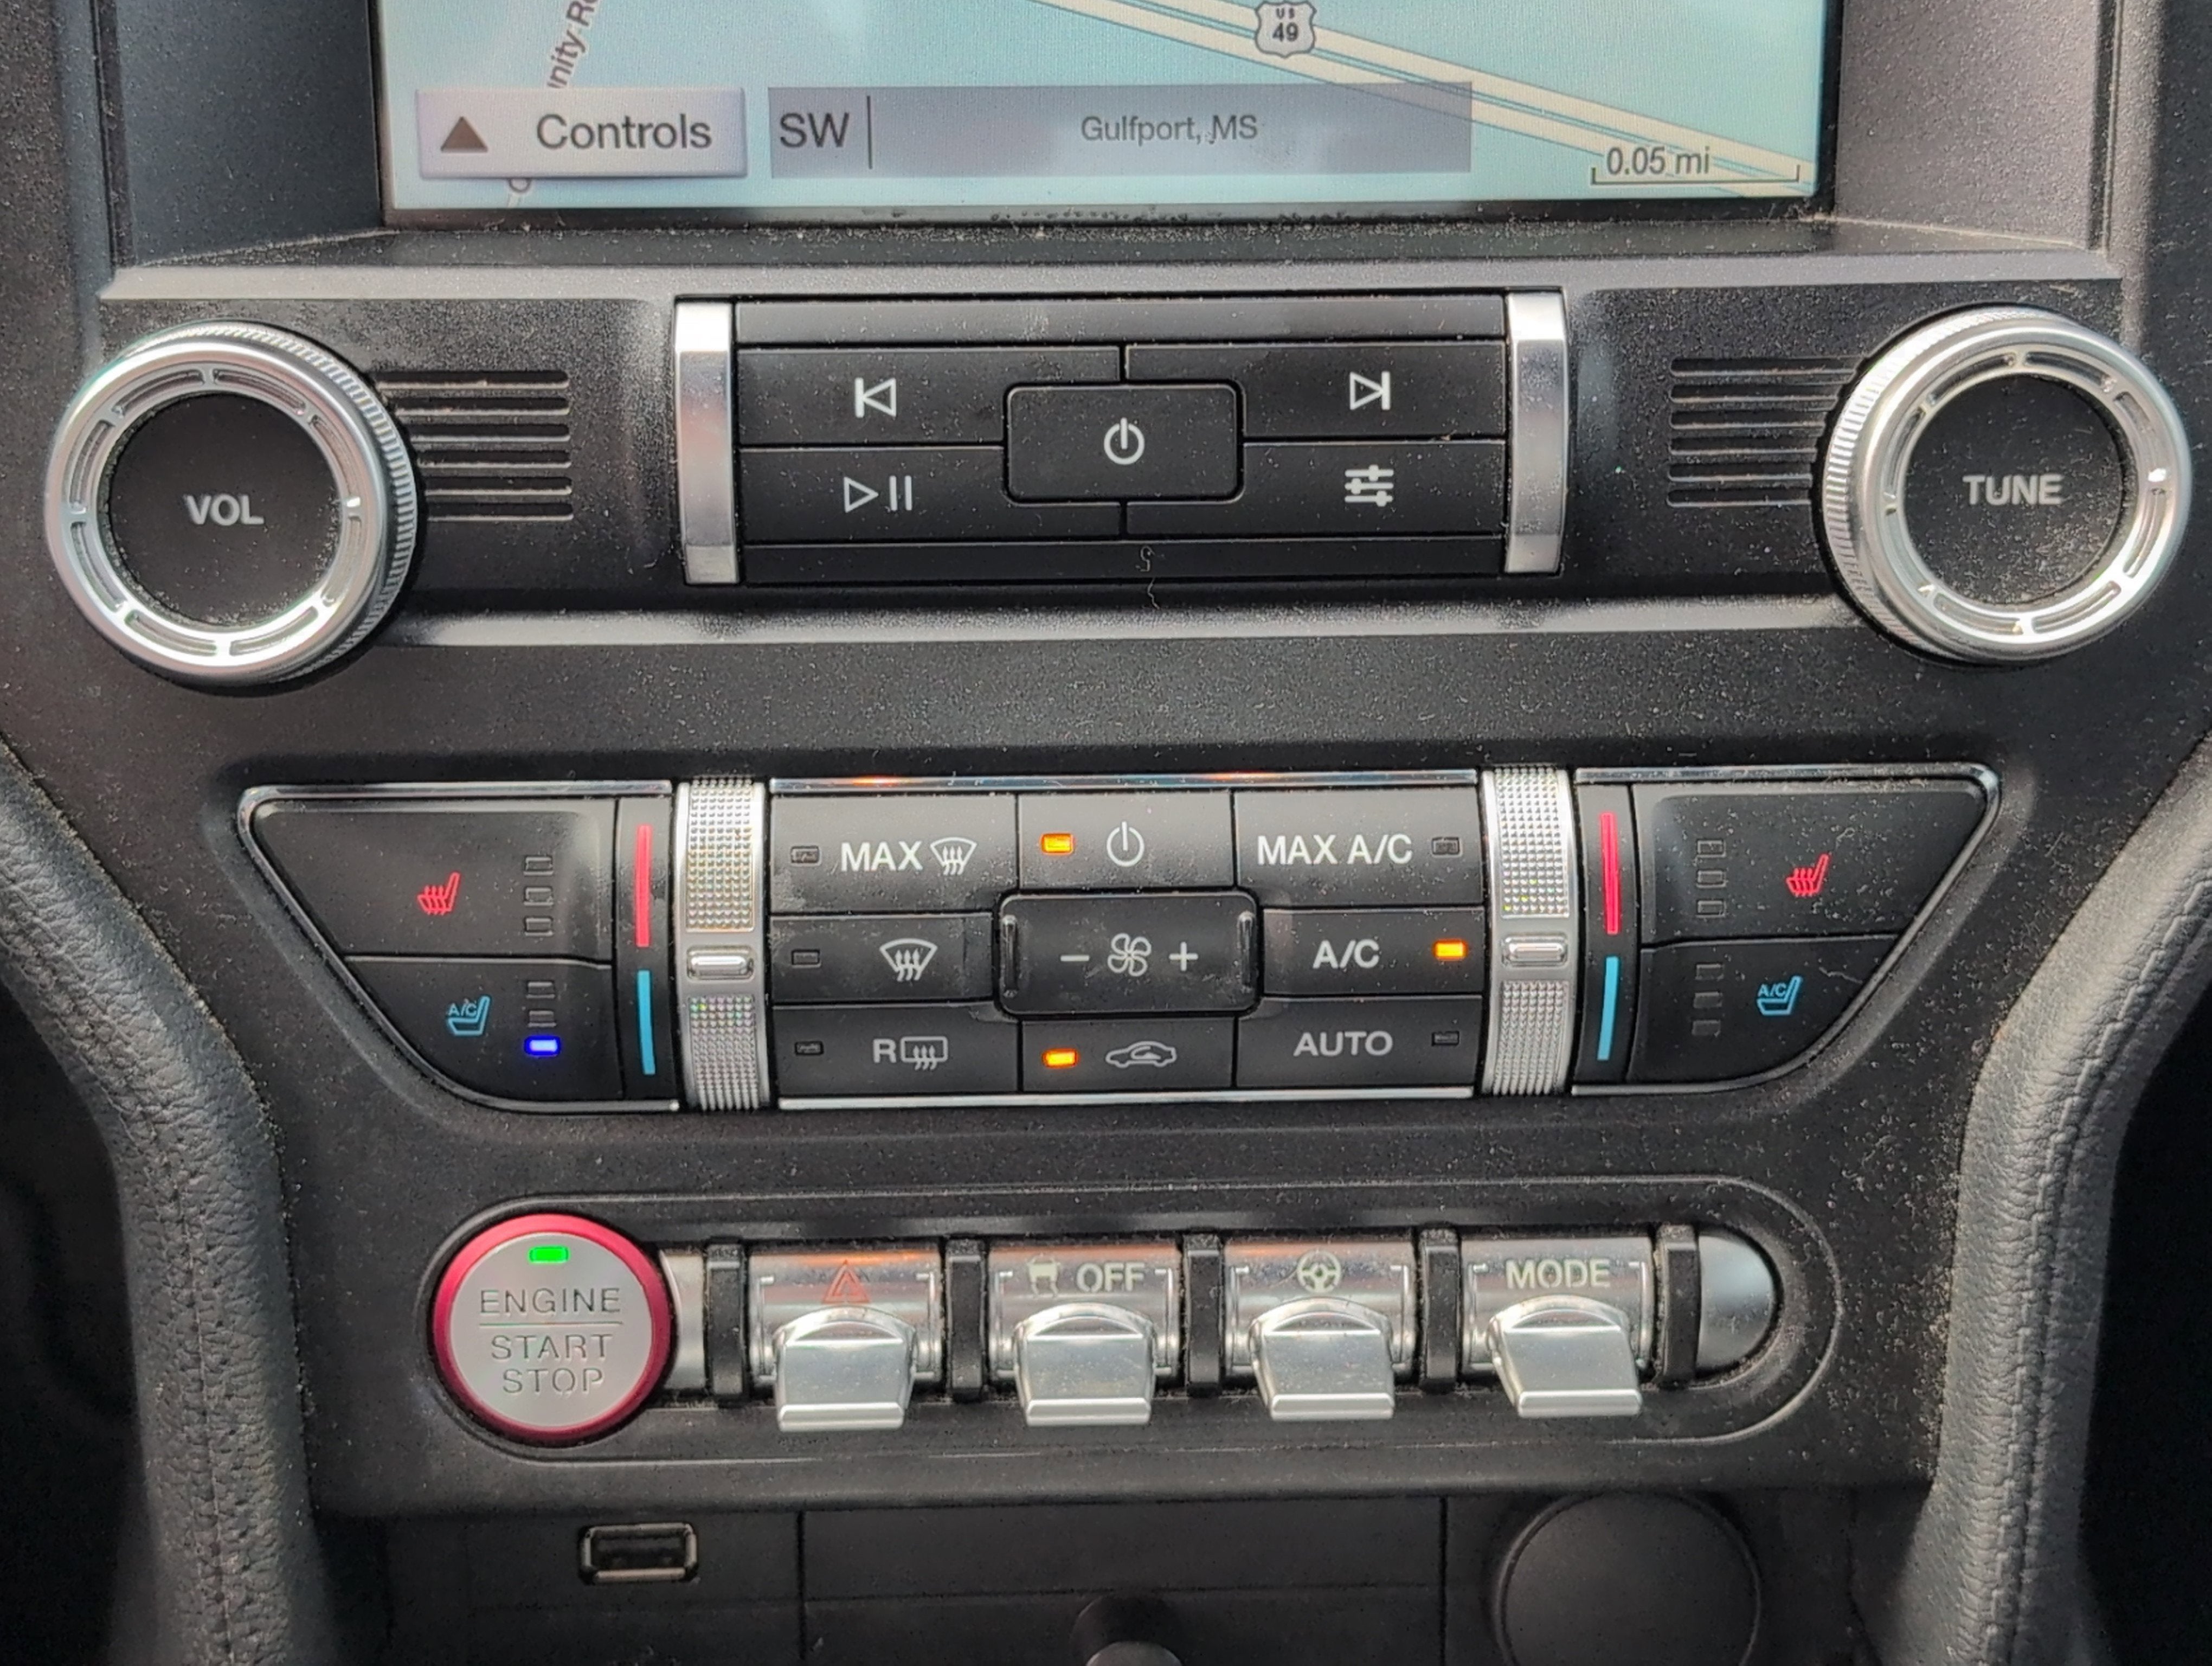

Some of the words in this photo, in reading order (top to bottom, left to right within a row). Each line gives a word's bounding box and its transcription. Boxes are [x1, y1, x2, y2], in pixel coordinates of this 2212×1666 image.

[1272, 22, 1298, 42] 49
[536, 113, 712, 150] Controls
[779, 112, 850, 149] SW
[1081, 115, 1202, 146] Gulfport,
[1212, 114, 1258, 140] MS
[1606, 147, 1666, 175] 0.05
[1674, 146, 1711, 175] mi
[1962, 473, 2065, 505] TUNE
[185, 494, 265, 526] VOL
[840, 841, 923, 872] MAX
[1257, 835, 1338, 866] MAX
[1347, 833, 1413, 864] A/C
[1313, 939, 1380, 970] A/C
[1758, 982, 1787, 997] A/C
[448, 1003, 478, 1016] A/C
[873, 1038, 897, 1063] R
[1293, 1030, 1394, 1057] AUTO
[1076, 1262, 1146, 1293] OFF
[1505, 1257, 1611, 1289] MODE
[479, 1287, 621, 1316] ENGINE
[491, 1334, 613, 1360] START
[502, 1368, 604, 1395] STOP
